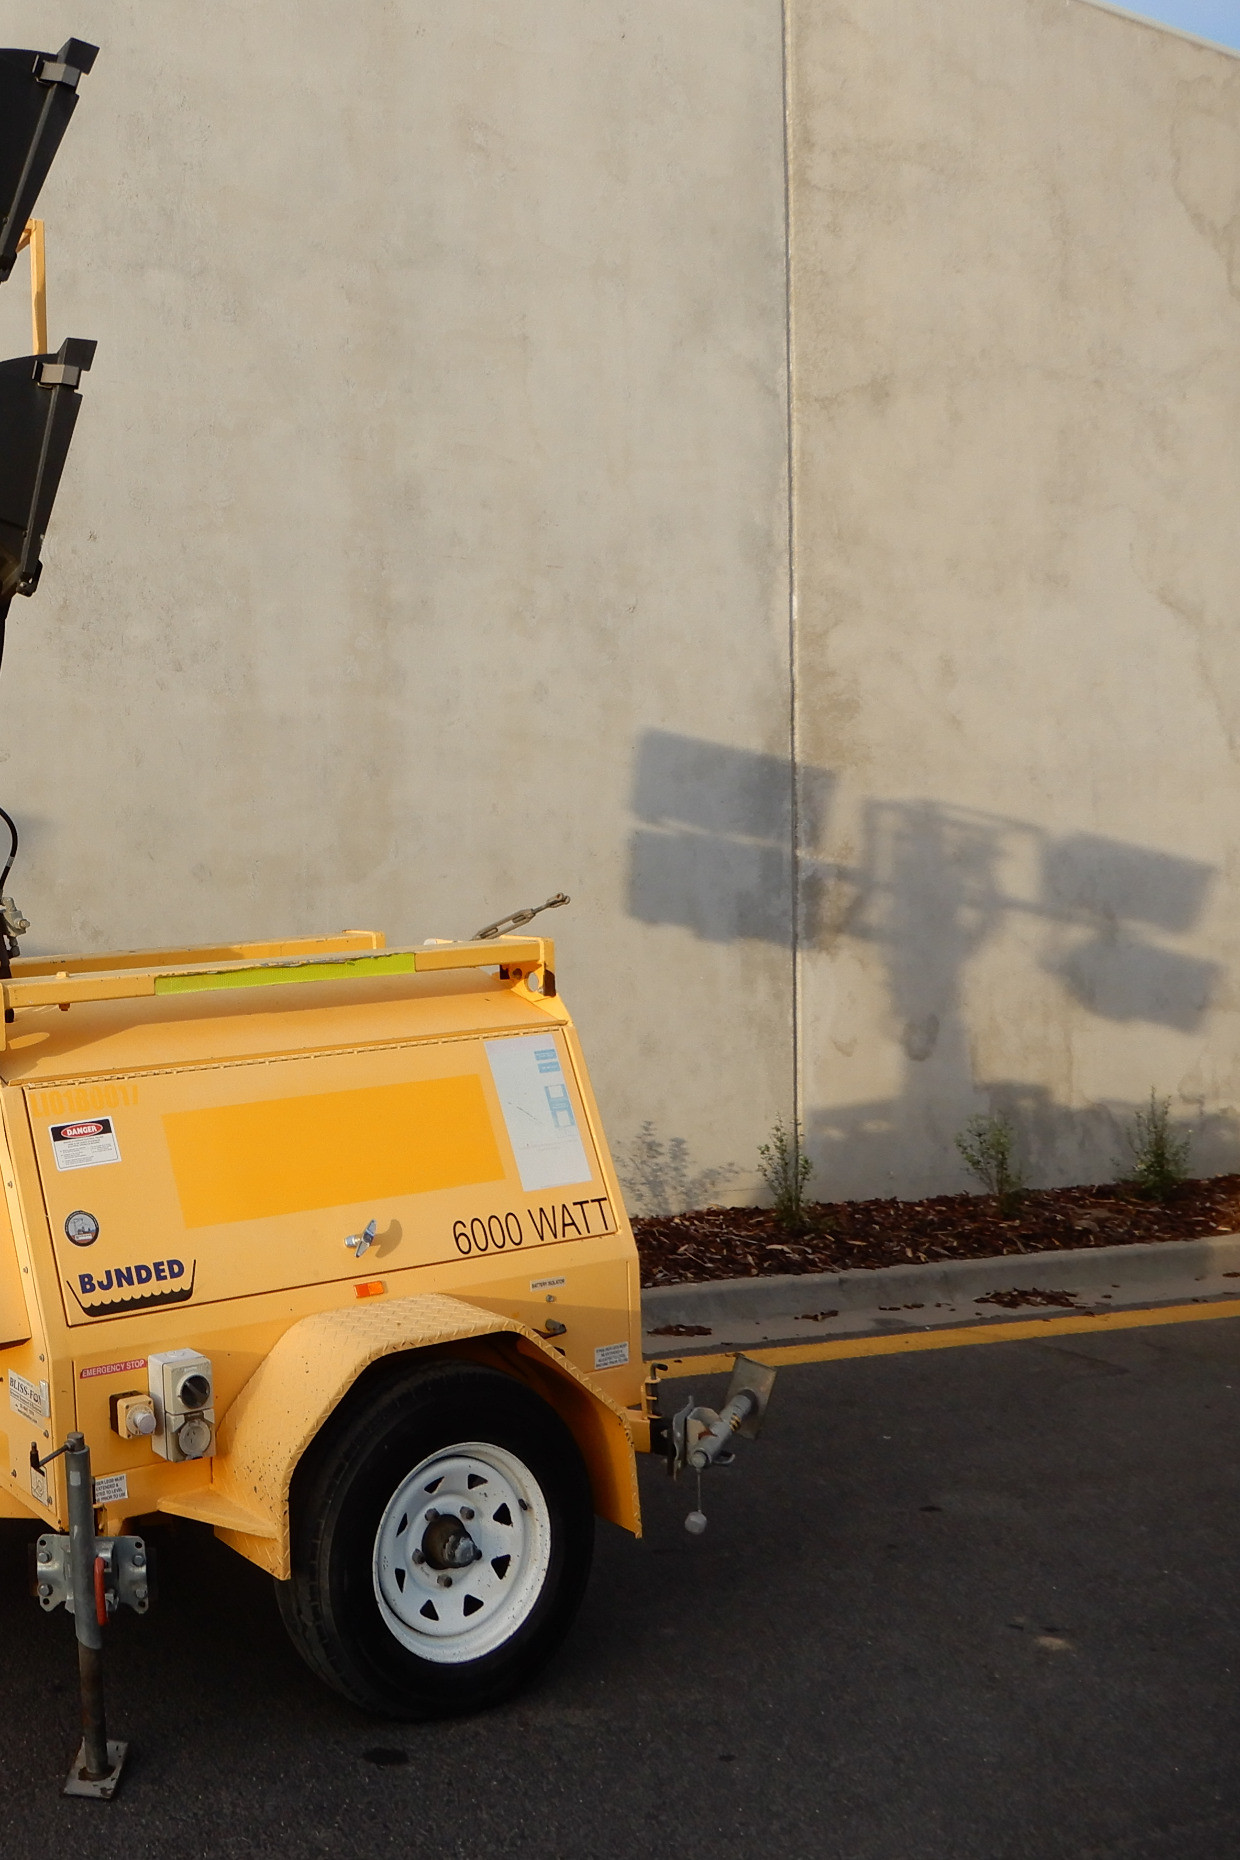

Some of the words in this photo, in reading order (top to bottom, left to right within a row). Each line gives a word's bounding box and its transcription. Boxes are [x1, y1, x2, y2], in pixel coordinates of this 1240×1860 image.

[66, 1125, 97, 1136] DANGER
[453, 1212, 523, 1255] 6000
[527, 1197, 608, 1241] WATT
[82, 1363, 125, 1377] EMERGENCY
[126, 1359, 144, 1370] STOP
